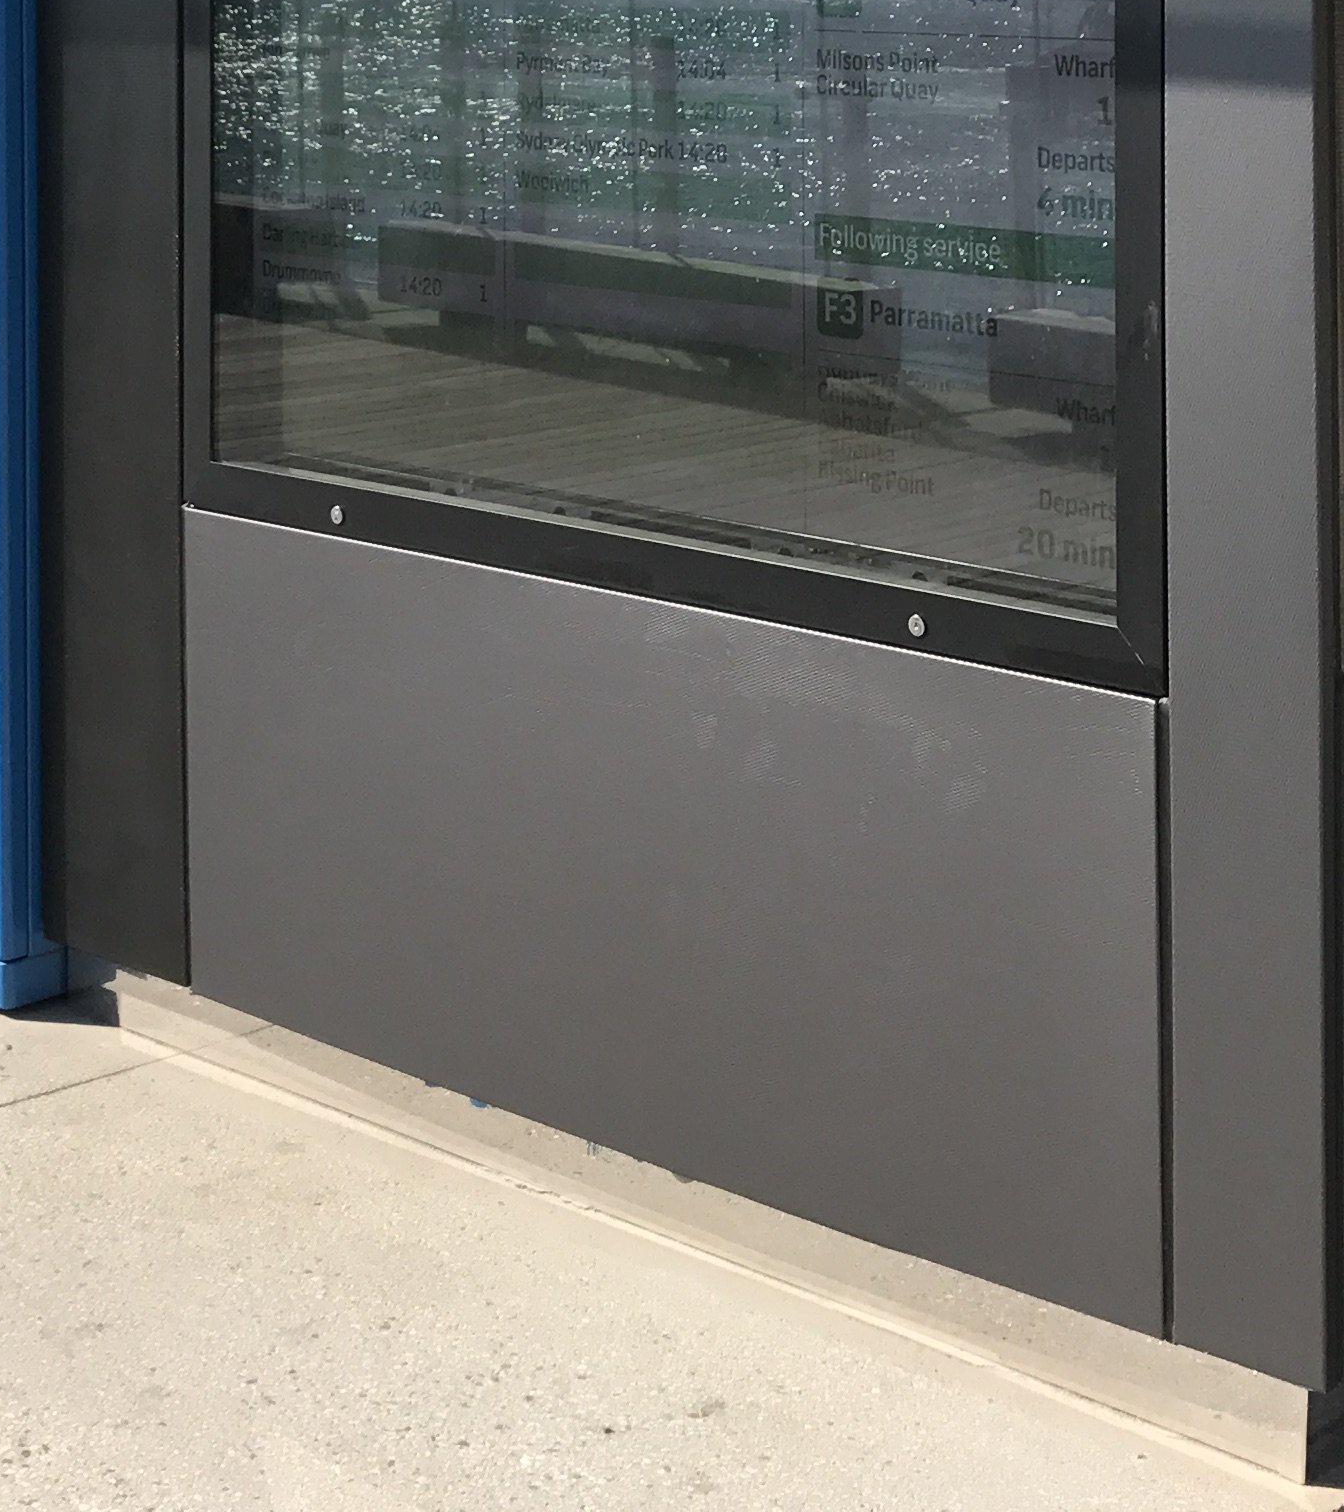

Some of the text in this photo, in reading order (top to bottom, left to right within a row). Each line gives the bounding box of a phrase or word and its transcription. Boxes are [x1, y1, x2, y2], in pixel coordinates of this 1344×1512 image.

[1055, 54, 1115, 79] Wharf
[1036, 144, 1115, 174] Departs
[1062, 190, 1115, 222] min
[819, 223, 1002, 263] Following service
[824, 291, 1000, 338] F3 Parramatta
[1056, 397, 1117, 427] Wharf
[1038, 487, 1117, 524] Departs
[1017, 525, 1116, 572] 20 min
